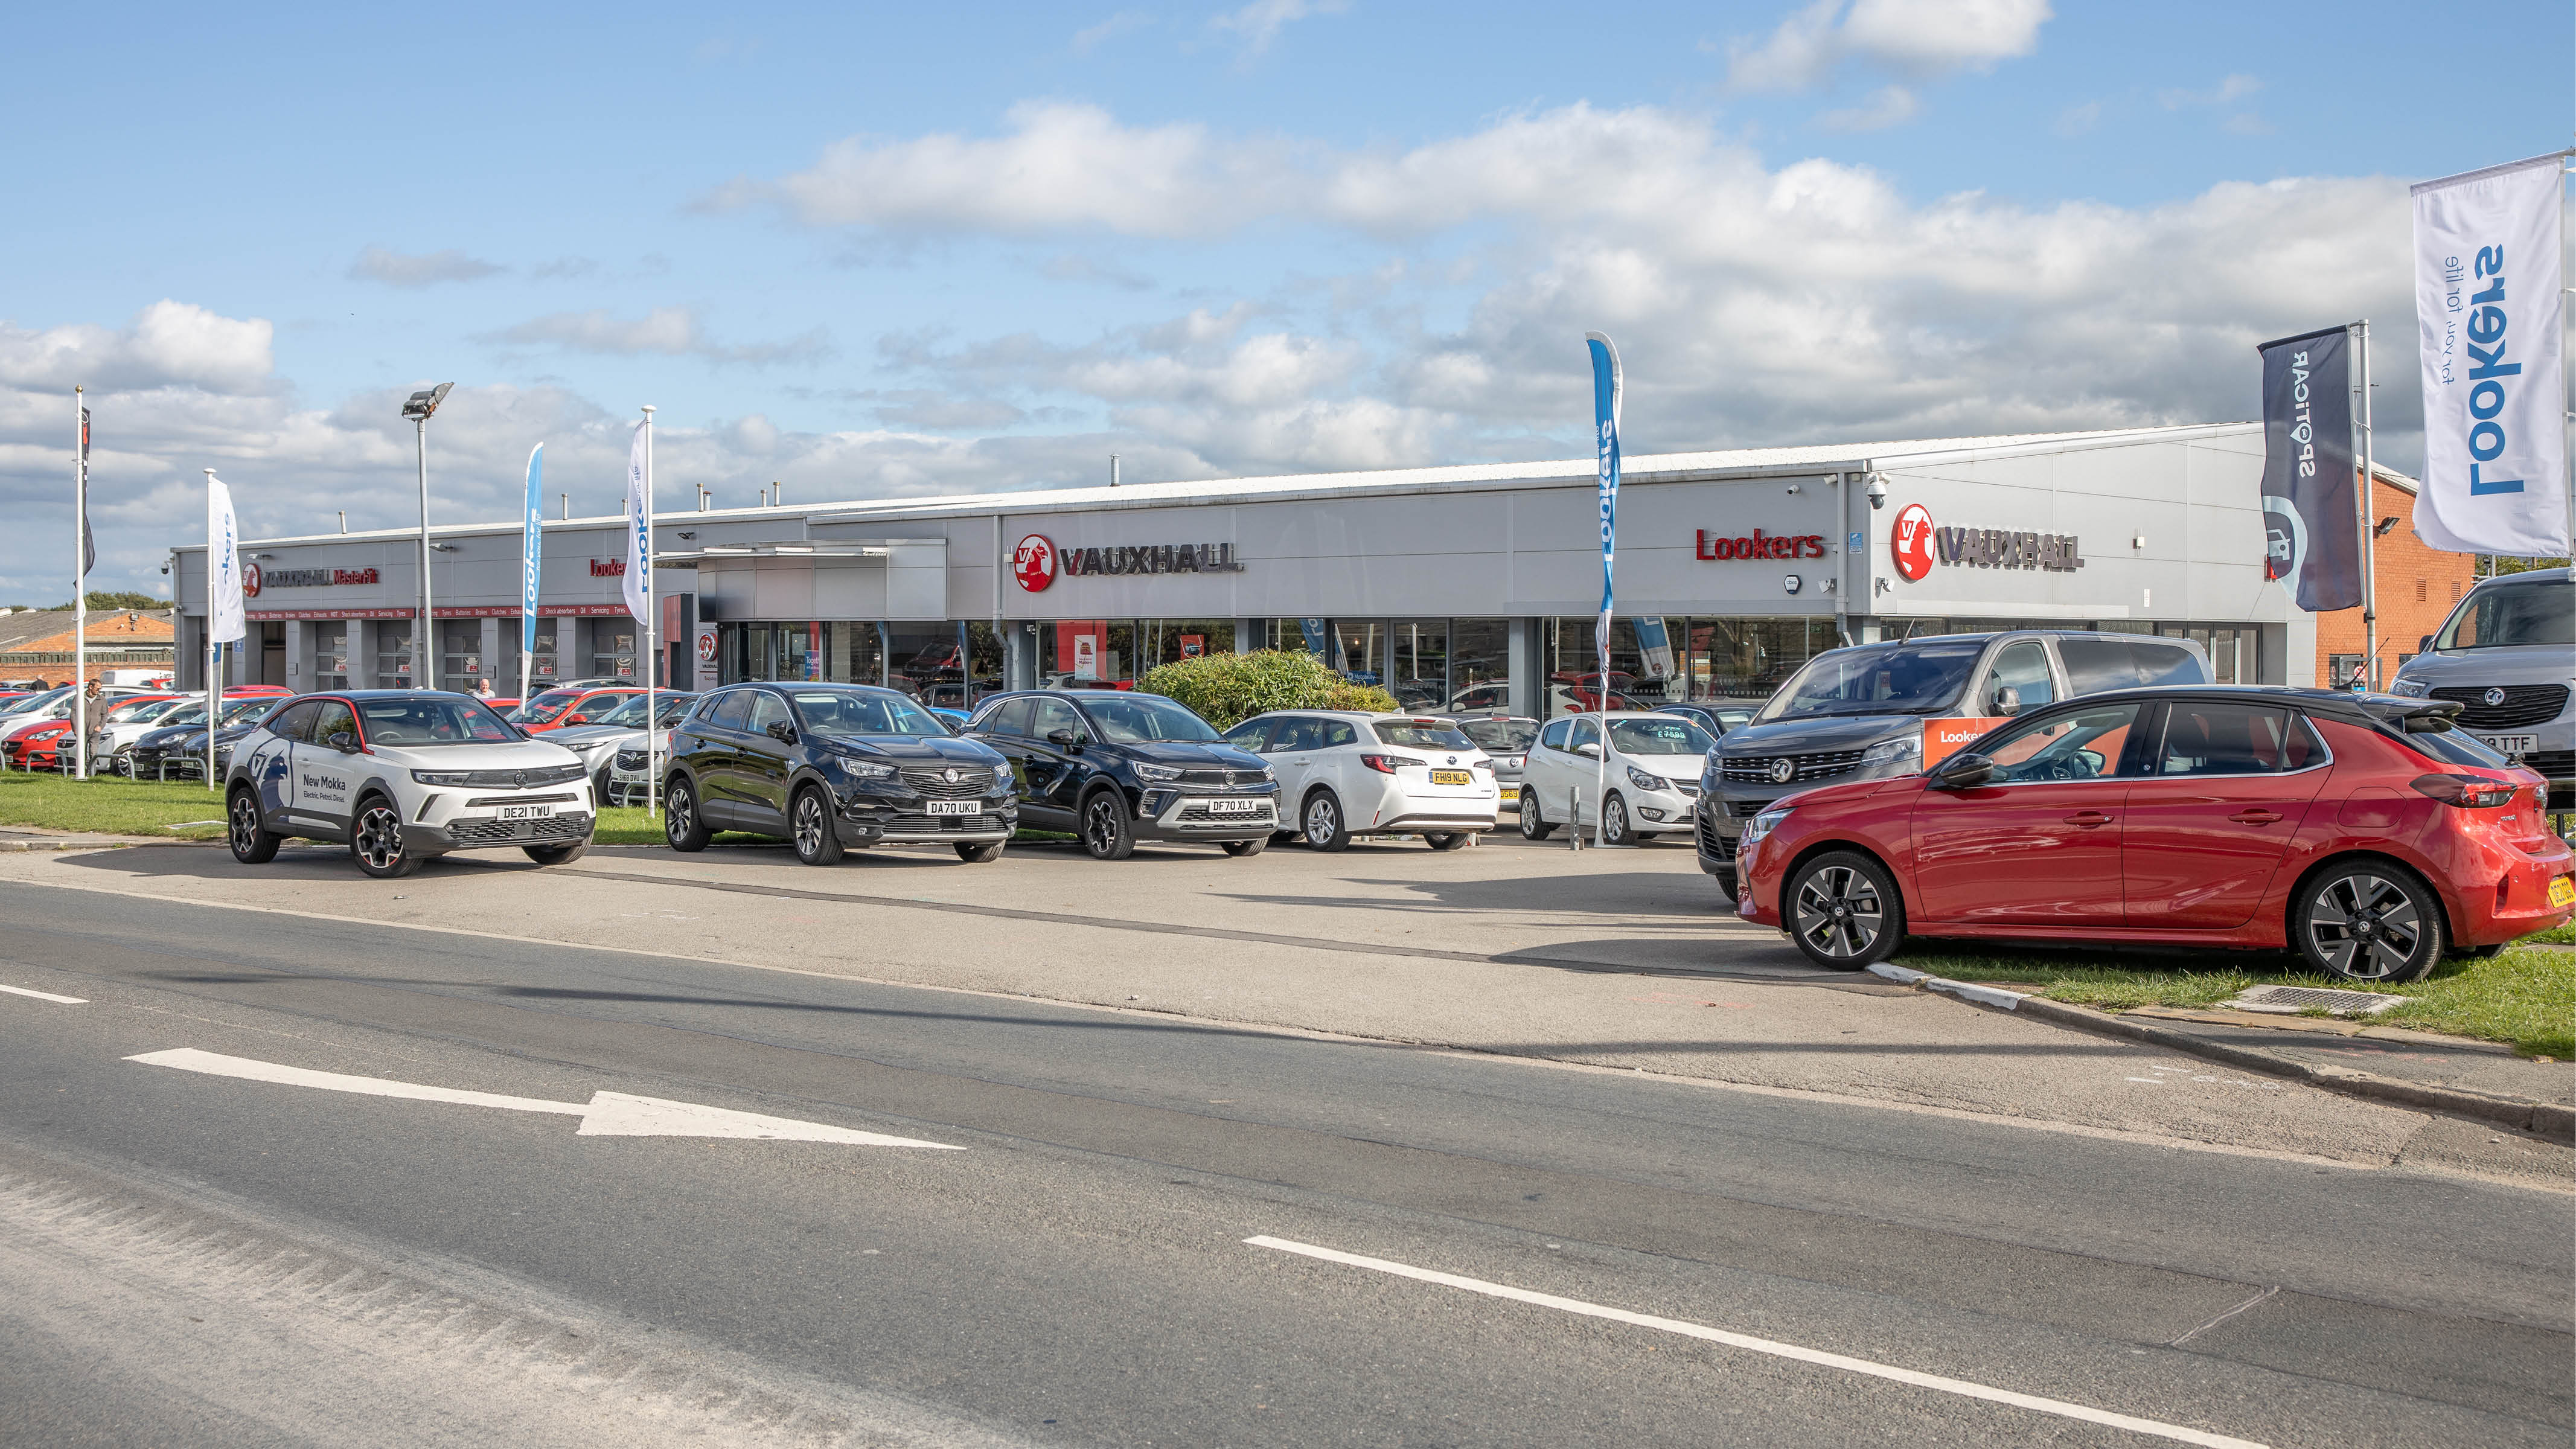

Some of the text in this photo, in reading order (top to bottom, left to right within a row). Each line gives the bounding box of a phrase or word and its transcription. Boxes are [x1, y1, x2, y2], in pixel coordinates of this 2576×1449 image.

[1696, 528, 1823, 560] Lookers
[1943, 526, 2085, 568] VAUXHALL
[526, 508, 536, 617] Lookers
[1060, 543, 1239, 576] VAUXHALL
[590, 558, 627, 577] Looke
[591, 606, 609, 615] Servicing
[1941, 731, 1984, 743] Looke
[2501, 737, 2530, 750] TTF
[304, 774, 346, 791] New Mokka
[1435, 773, 1467, 782] FH19 NLG
[504, 805, 549, 818] DE21 TWU
[931, 802, 977, 813] DA70 UKU
[1213, 800, 1253, 811] DF70 XLX
